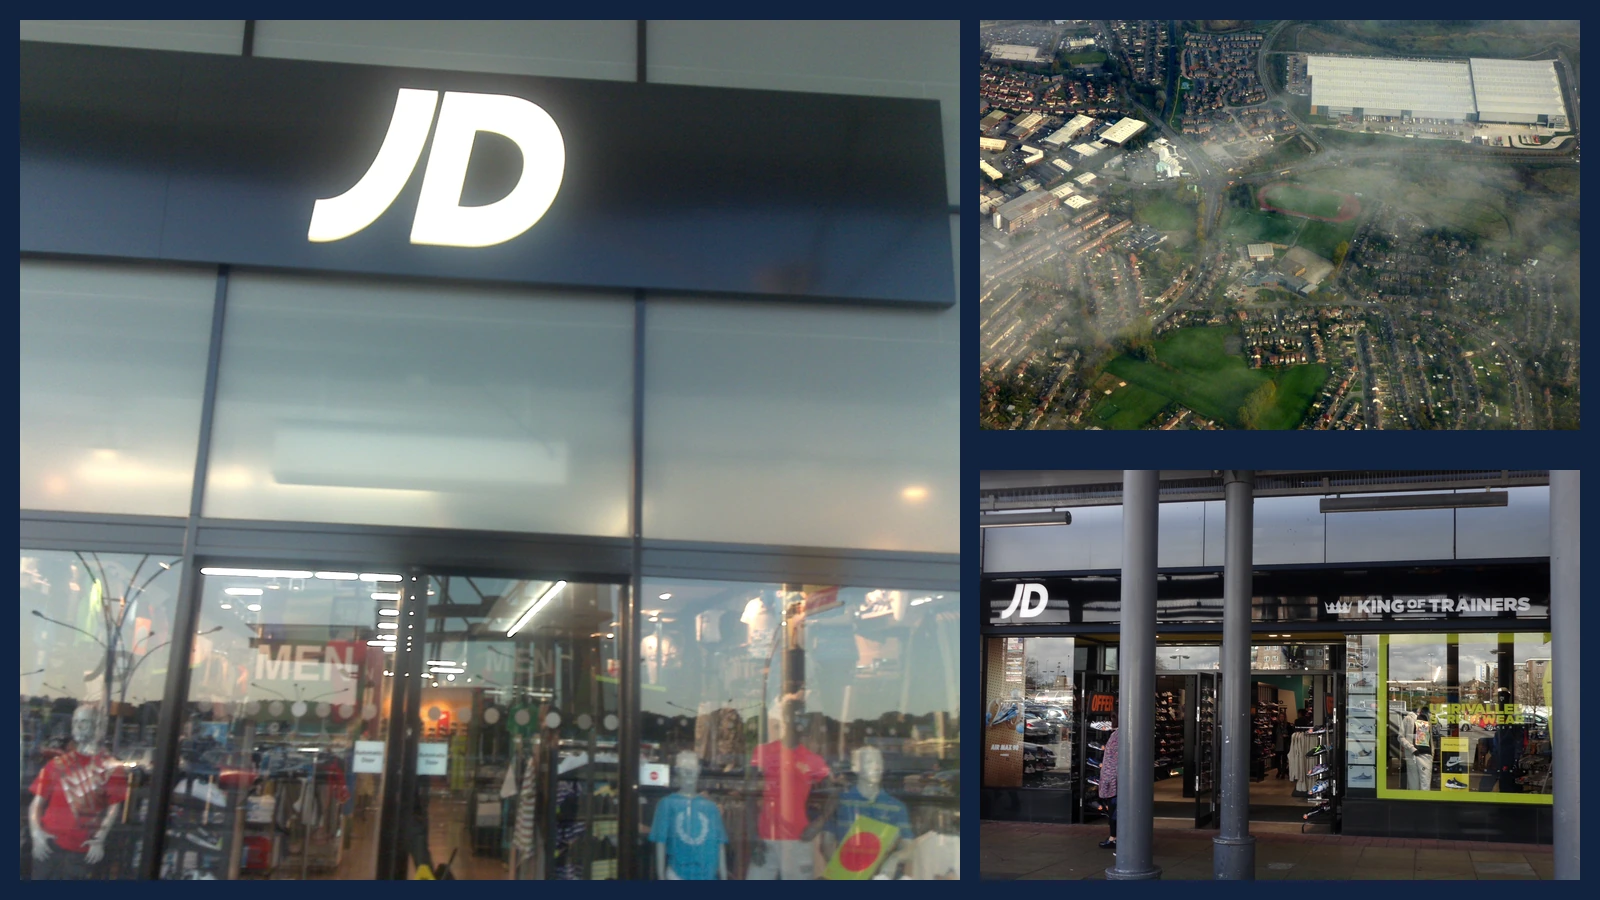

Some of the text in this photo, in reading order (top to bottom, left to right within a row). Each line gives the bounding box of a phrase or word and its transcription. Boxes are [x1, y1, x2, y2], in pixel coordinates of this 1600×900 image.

[308, 87, 566, 248] JD
[1001, 583, 1049, 619] JD
[1357, 597, 1531, 614] KING OF TRAINERS
[255, 644, 358, 681] MEN
[486, 648, 553, 673] MEN
[1092, 694, 1115, 712] OFFER
